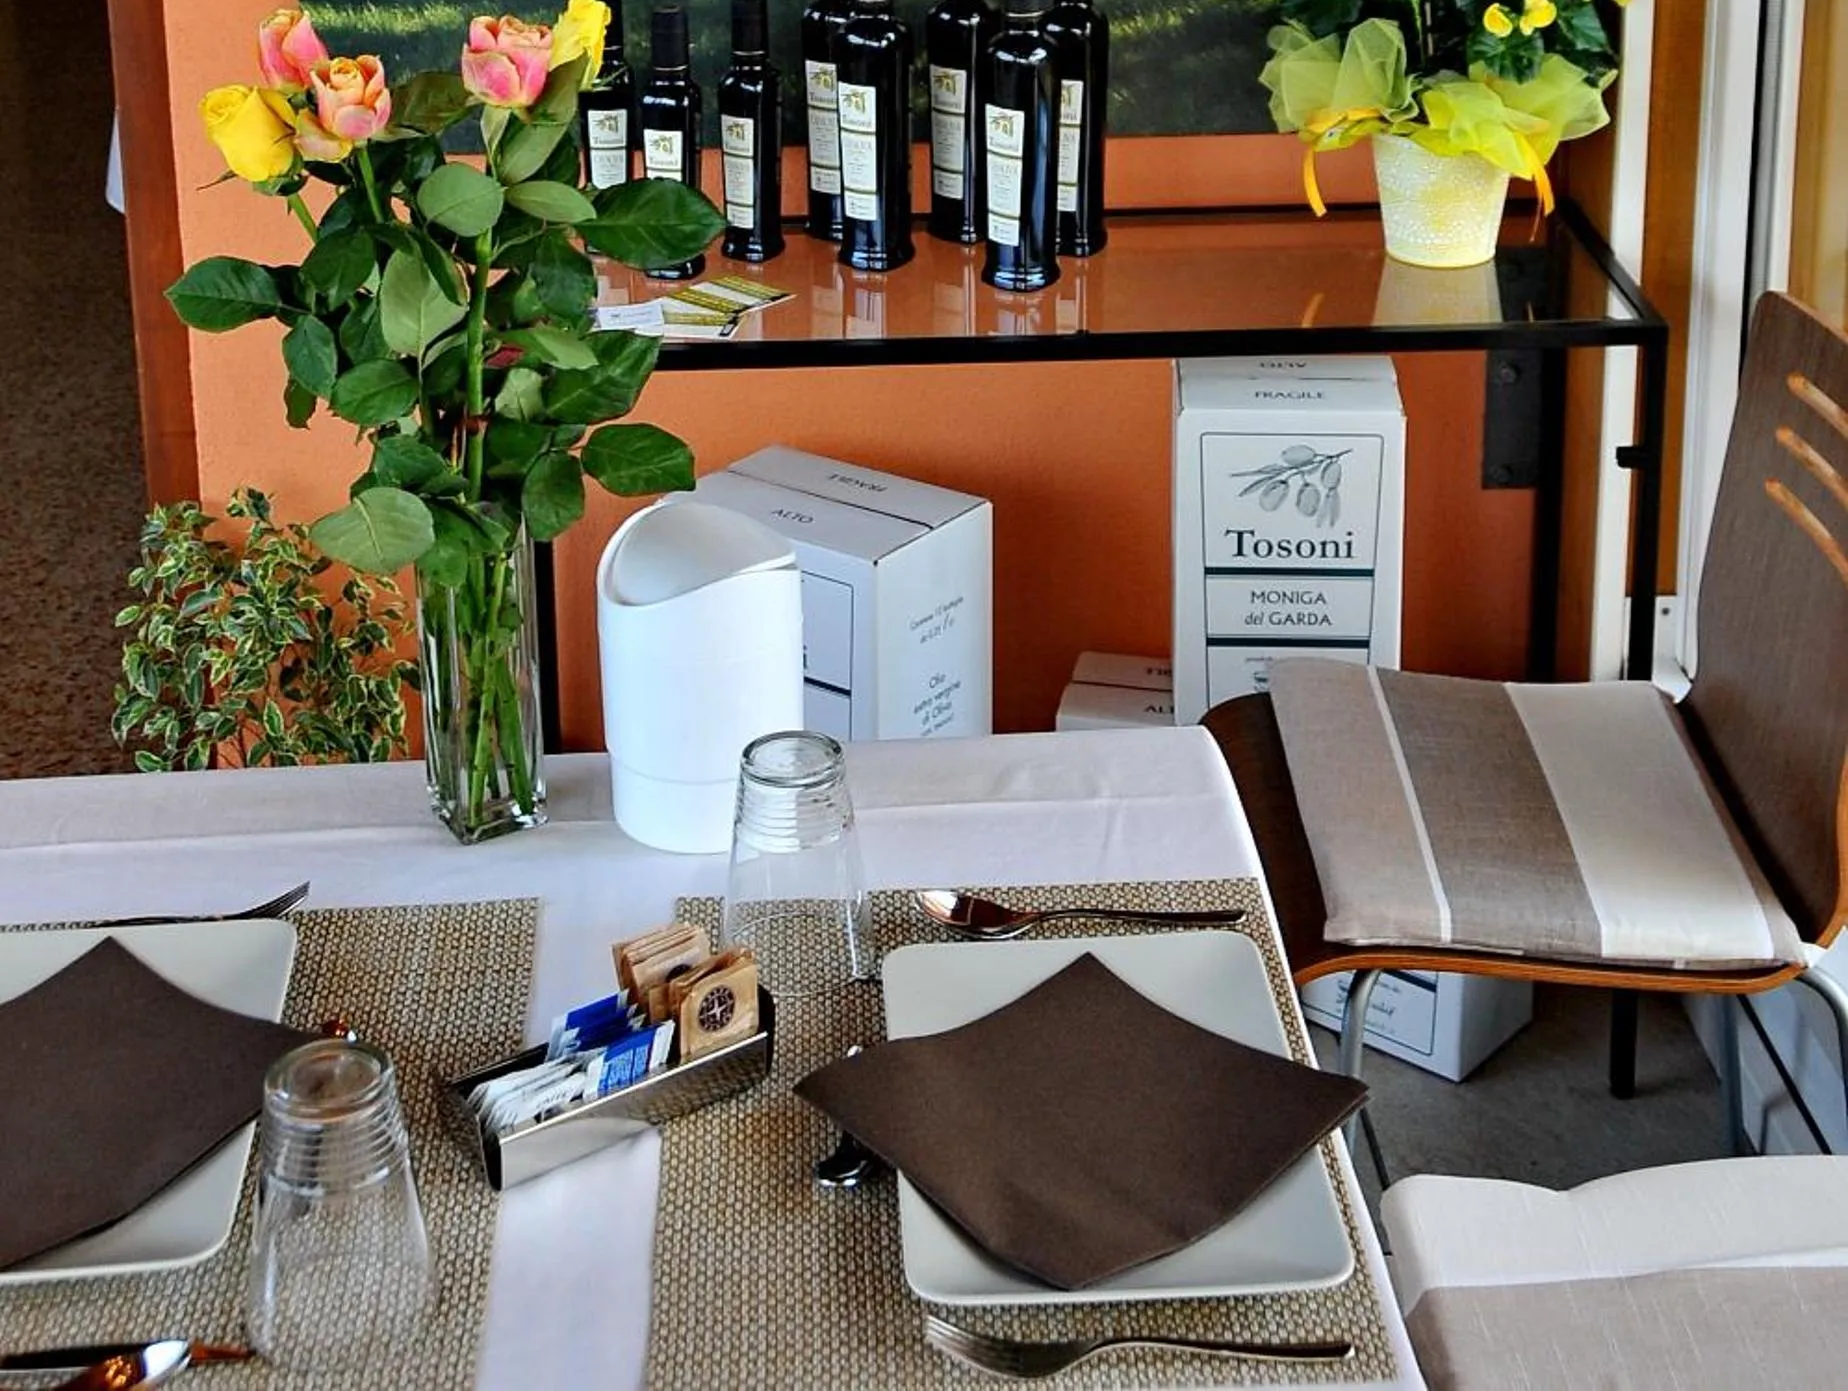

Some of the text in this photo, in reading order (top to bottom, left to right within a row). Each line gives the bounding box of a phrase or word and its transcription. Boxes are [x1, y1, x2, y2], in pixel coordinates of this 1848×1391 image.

[1254, 390, 1326, 400] FRAGILE
[770, 508, 815, 524] ALTO
[1225, 528, 1357, 559] Tosoni
[1250, 589, 1327, 606] MONIGA
[1244, 610, 1332, 627] del GARDA
